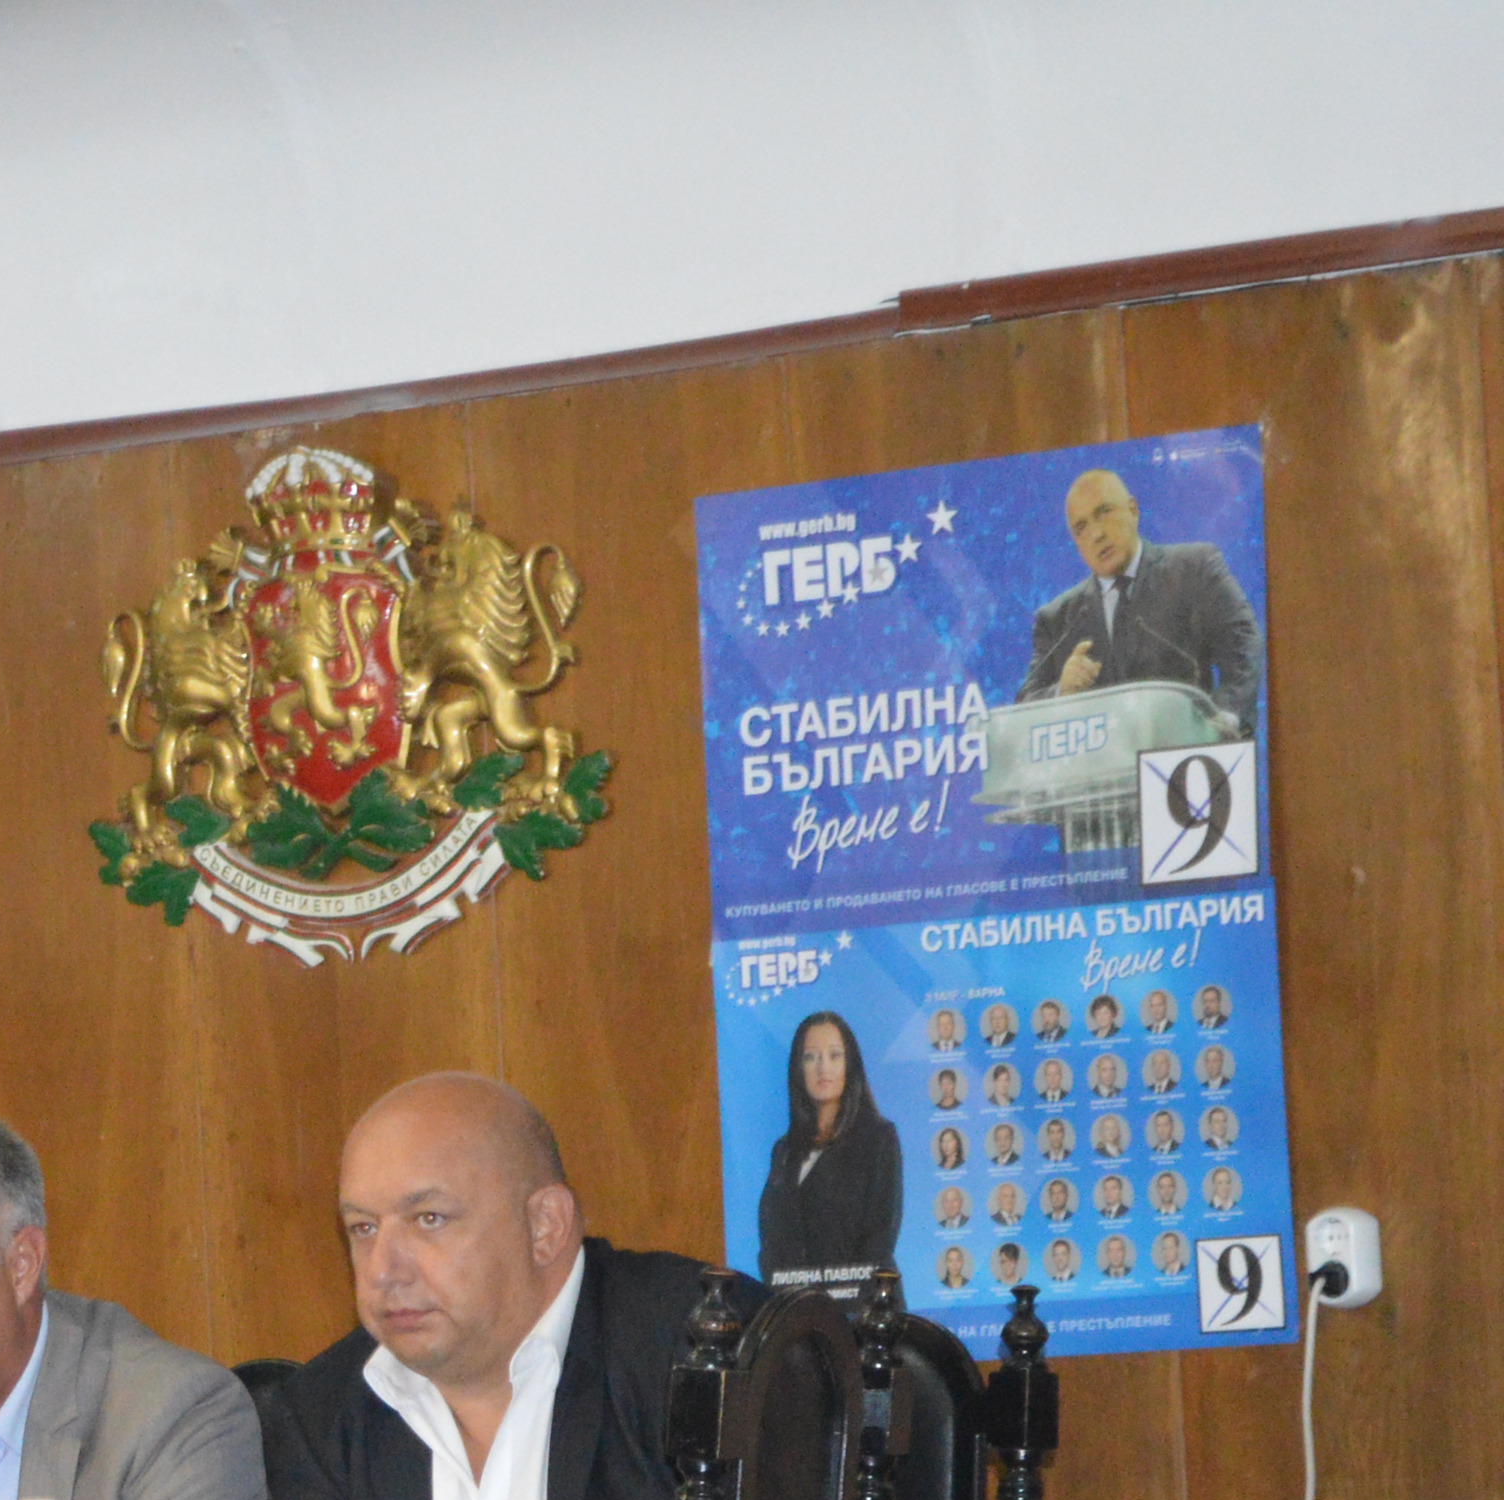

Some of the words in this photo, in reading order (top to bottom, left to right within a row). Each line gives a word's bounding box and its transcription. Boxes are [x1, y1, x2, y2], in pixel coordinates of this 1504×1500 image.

[758, 511, 856, 541] www.gerb.bg
[762, 535, 896, 606] ГЕРБ
[738, 681, 990, 749] СТАБИЛНА
[1030, 715, 1107, 763] ГЕРБ
[743, 730, 989, 797] БЪЛГАРИЯ
[788, 795, 896, 873] Време
[1166, 753, 1232, 874] 9
[199, 847, 345, 913] СЪЕДИНЕНИЕТО
[355, 877, 413, 910] ПРАВИ
[421, 816, 477, 876] СИЛАТА
[725, 898, 811, 919] КУПУВАНЕТО
[825, 887, 921, 910] ПРОДАВАНЕТО
[924, 885, 943, 899] НА
[946, 879, 1007, 897] ГЛАСОВЕ
[1022, 867, 1129, 889] ПРЕСТЪПЛЕНИЕ
[920, 911, 1087, 953] СТАБИЛНА
[1096, 894, 1264, 936] БЪЛГАРИЯ
[739, 950, 819, 989] ГЕРБ
[1217, 1243, 1263, 1324] 9
